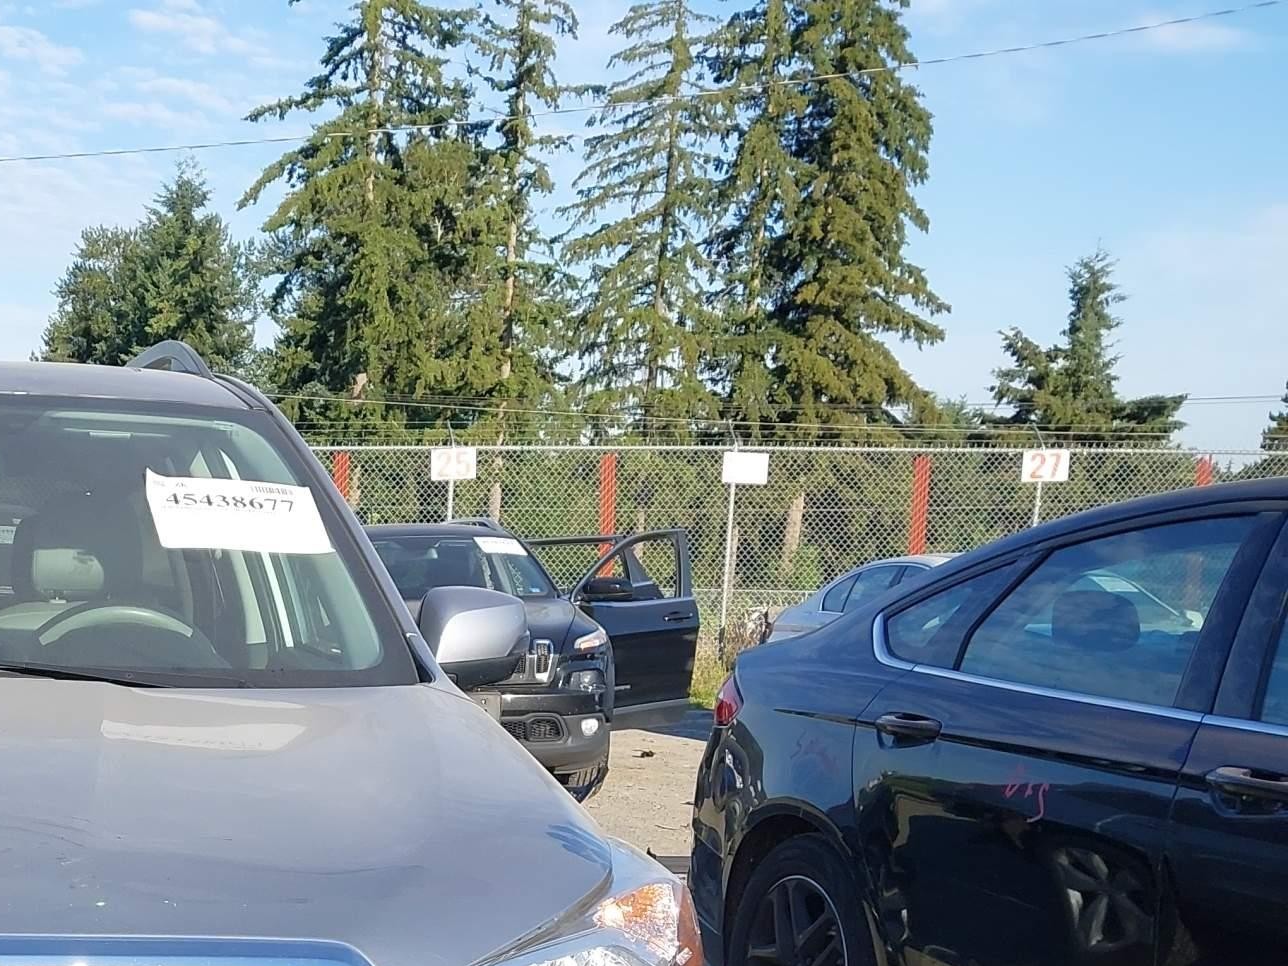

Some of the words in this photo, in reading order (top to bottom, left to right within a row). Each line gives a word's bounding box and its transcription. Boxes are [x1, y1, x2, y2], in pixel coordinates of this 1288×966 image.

[437, 450, 471, 478] 25
[1030, 452, 1062, 479] 27
[166, 492, 293, 513] 45438677
